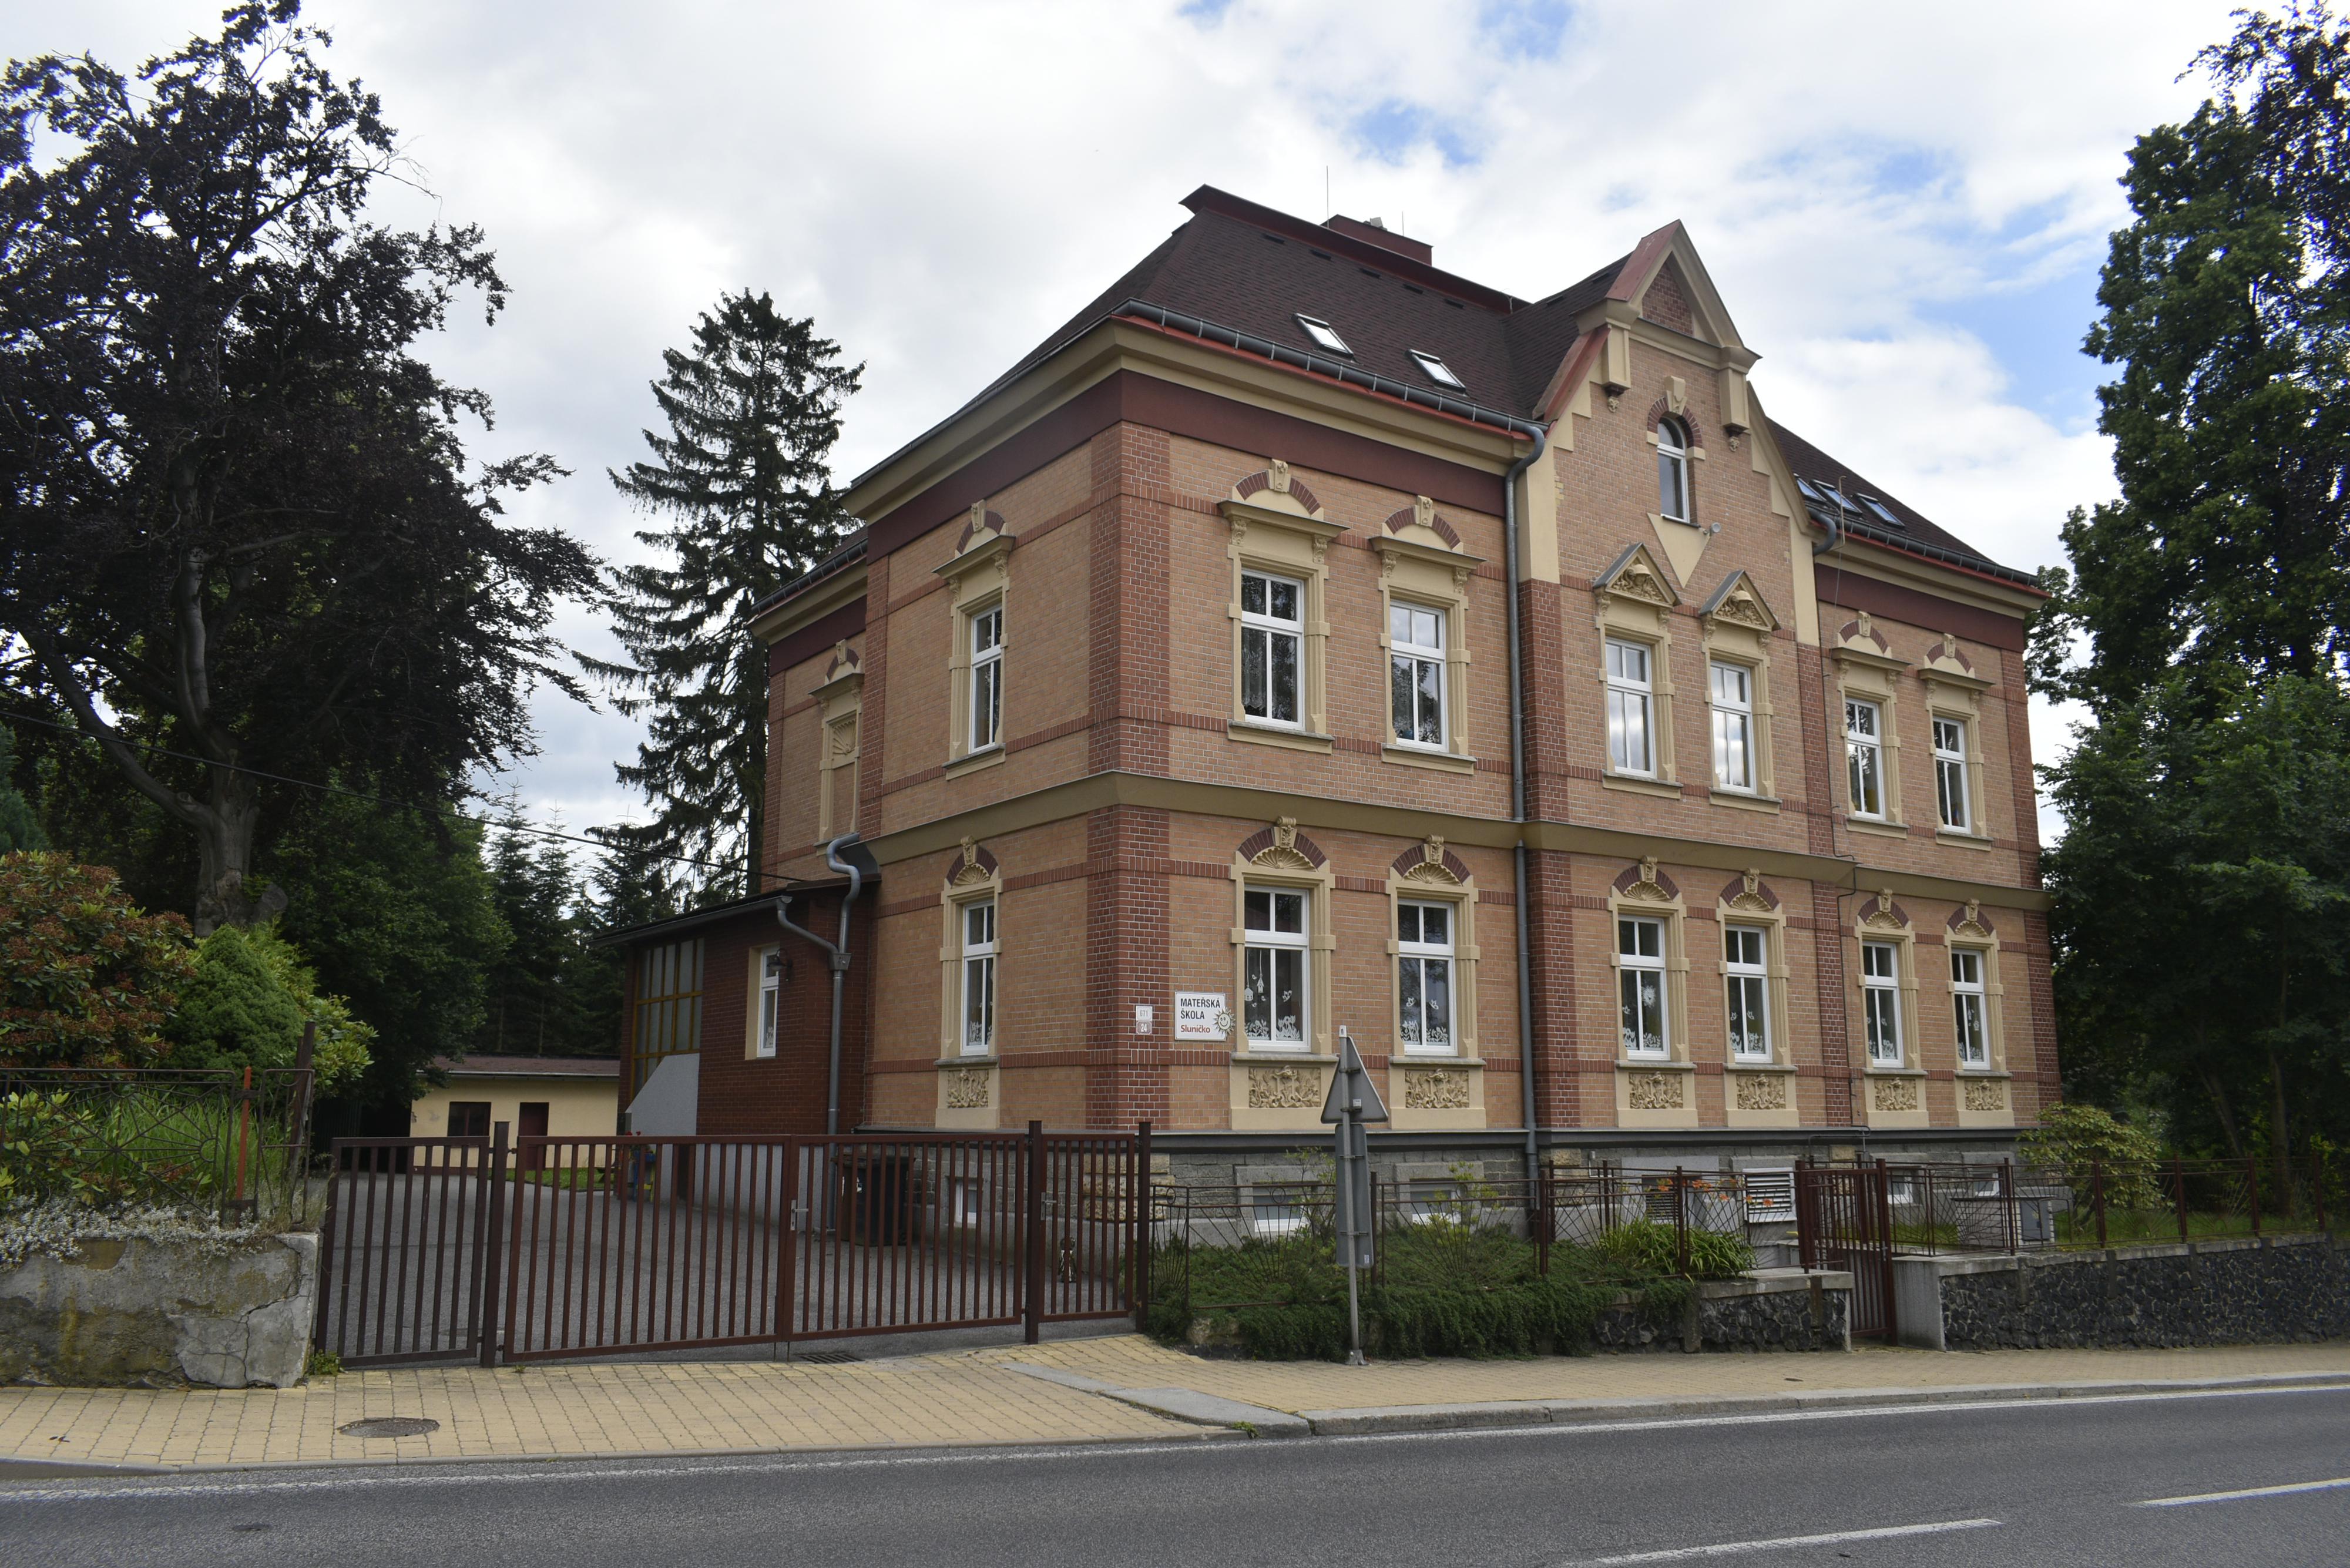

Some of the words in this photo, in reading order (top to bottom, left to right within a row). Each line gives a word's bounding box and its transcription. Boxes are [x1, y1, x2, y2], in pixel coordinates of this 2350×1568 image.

[1180, 997, 1220, 1008] MATEŘSKÁ
[1180, 1008, 1205, 1019] ŠKOLA
[1140, 1023, 1147, 1032] 24
[1180, 1025, 1211, 1033] Sluníčko
